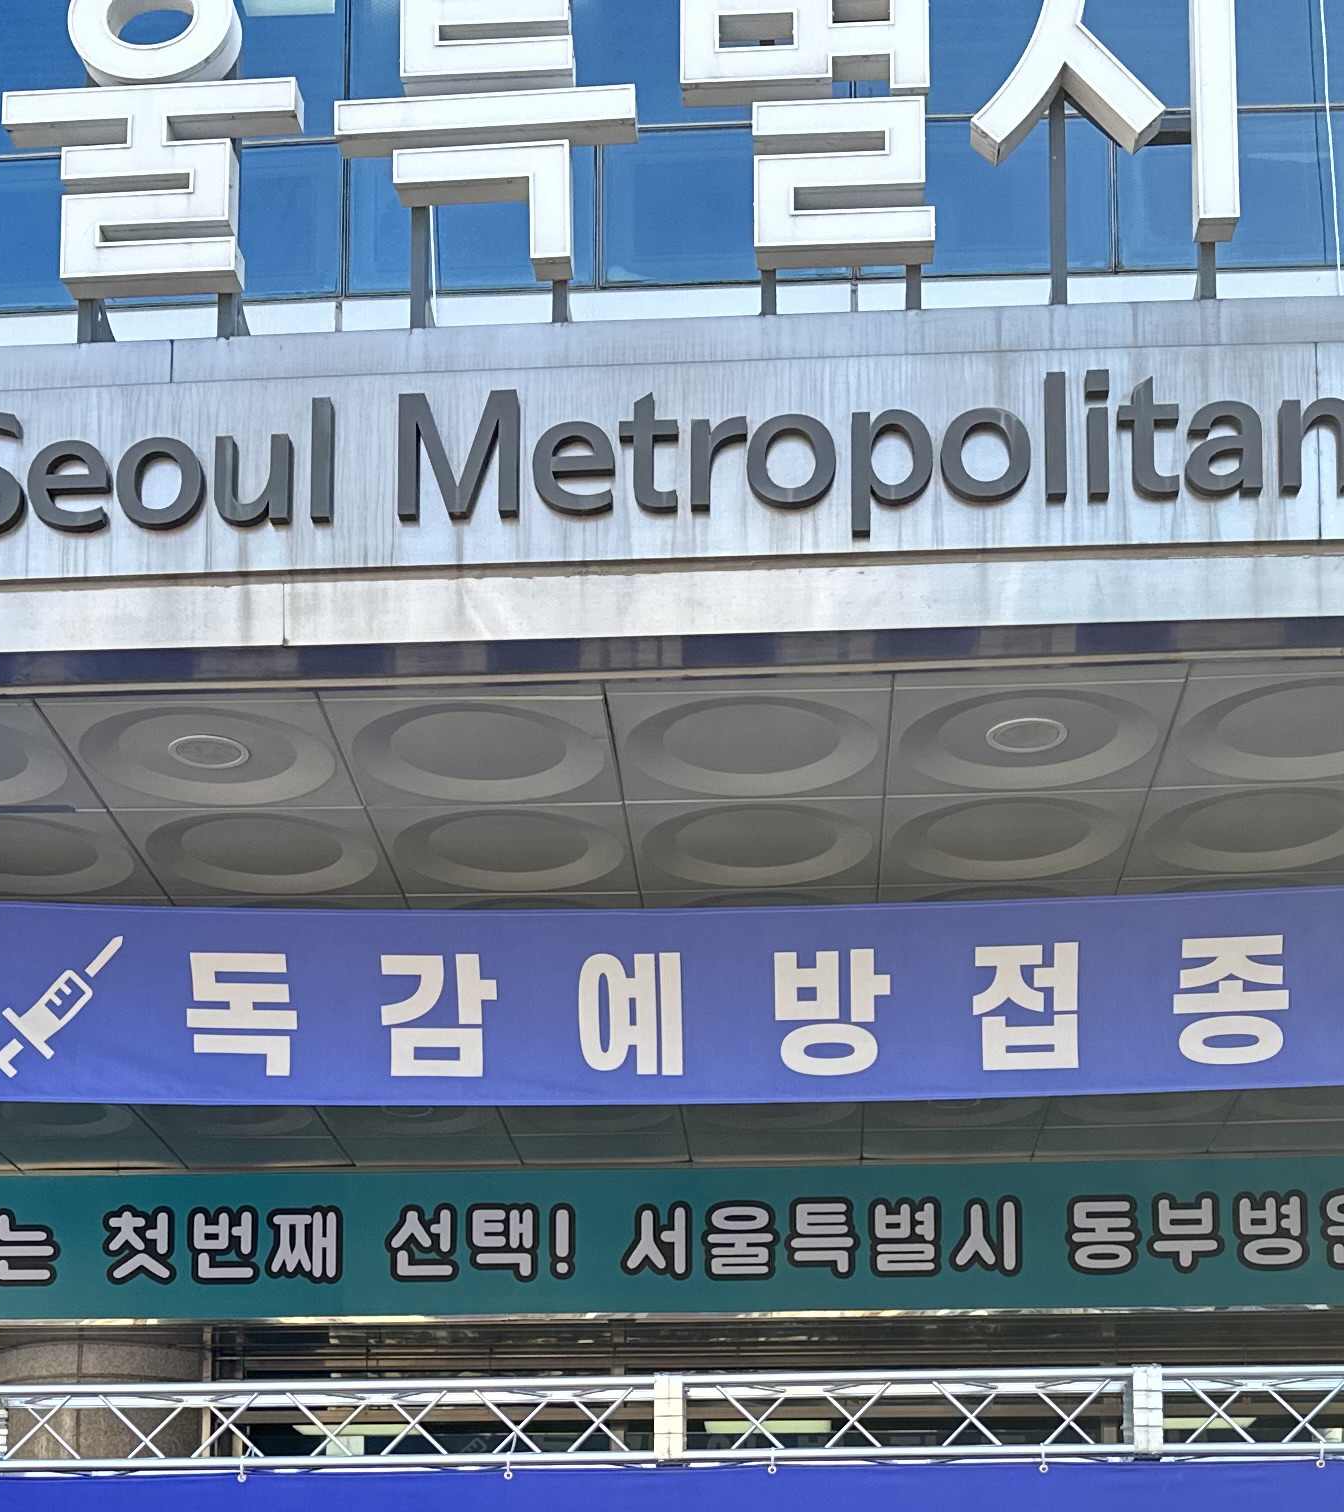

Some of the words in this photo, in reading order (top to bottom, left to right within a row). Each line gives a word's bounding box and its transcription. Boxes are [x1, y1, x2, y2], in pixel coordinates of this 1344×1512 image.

[104, 1203, 343, 1284] 첫번째
[388, 1200, 576, 1282] 선택!
[625, 1197, 1025, 1278] 서울특별시
